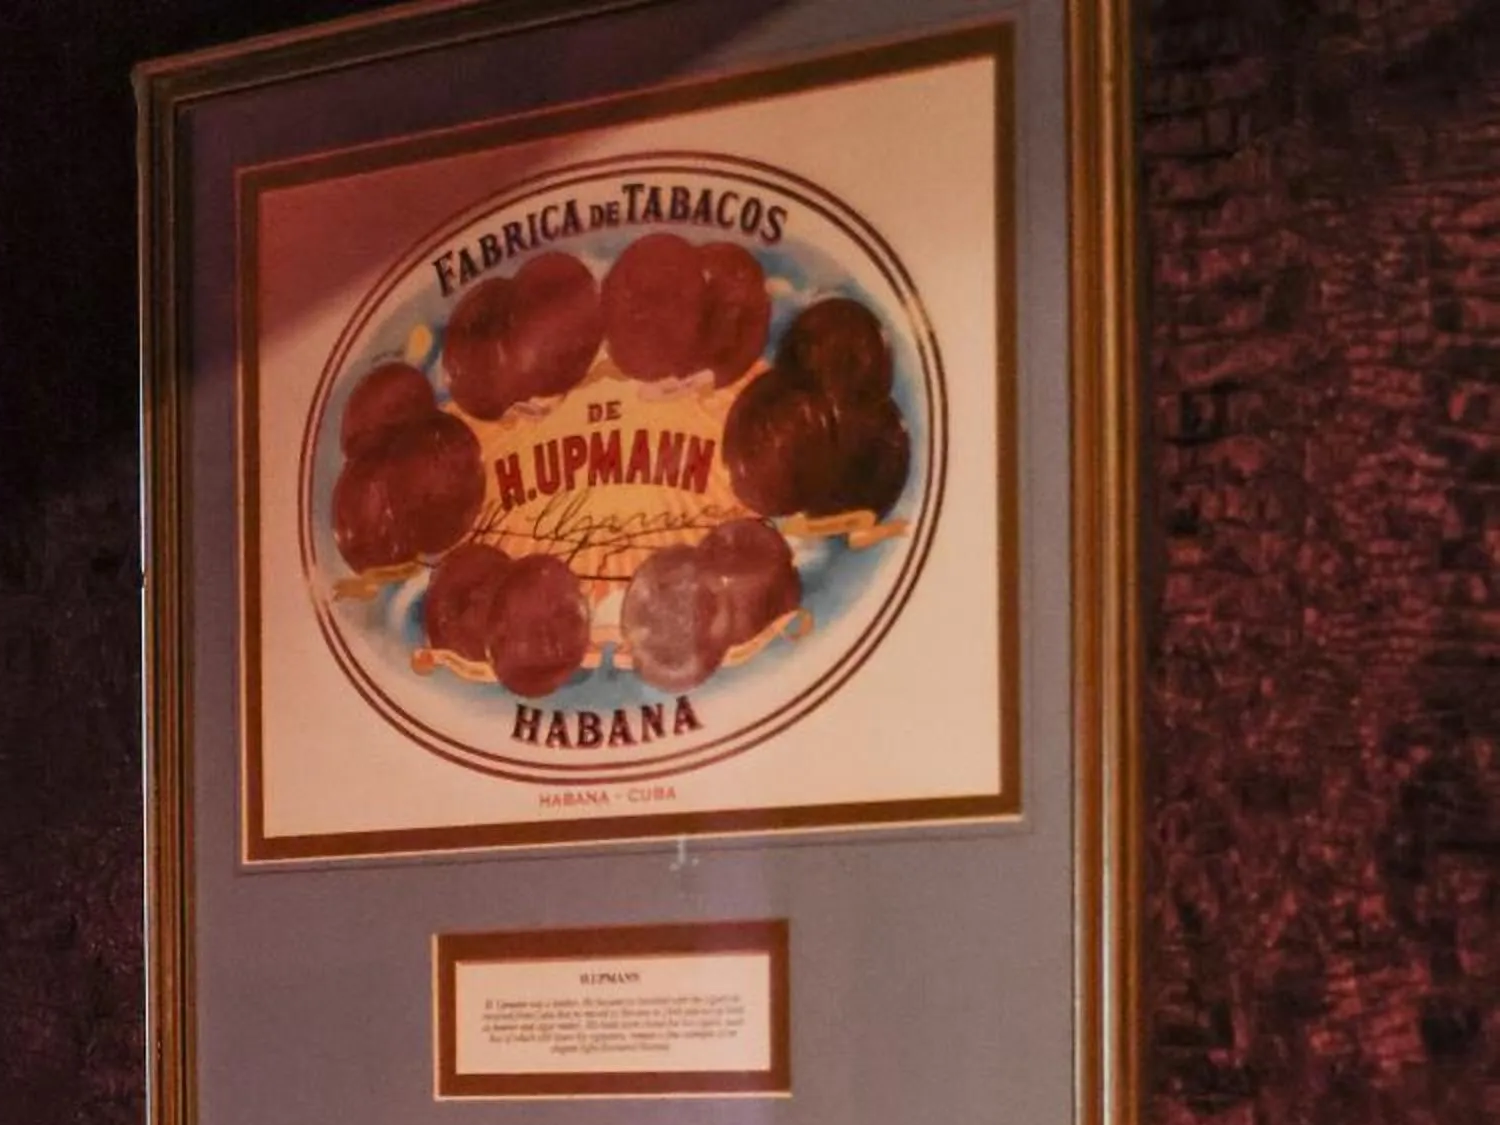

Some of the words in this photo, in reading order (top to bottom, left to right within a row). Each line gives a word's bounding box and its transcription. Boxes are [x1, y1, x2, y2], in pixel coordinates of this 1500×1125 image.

[431, 198, 583, 298] FABRICA
[589, 201, 620, 229] DE
[622, 183, 788, 245] TABACOS
[587, 401, 622, 423] DE
[511, 695, 703, 749] HABANA
[538, 790, 610, 808] HABANA
[627, 786, 677, 803] CUBA
